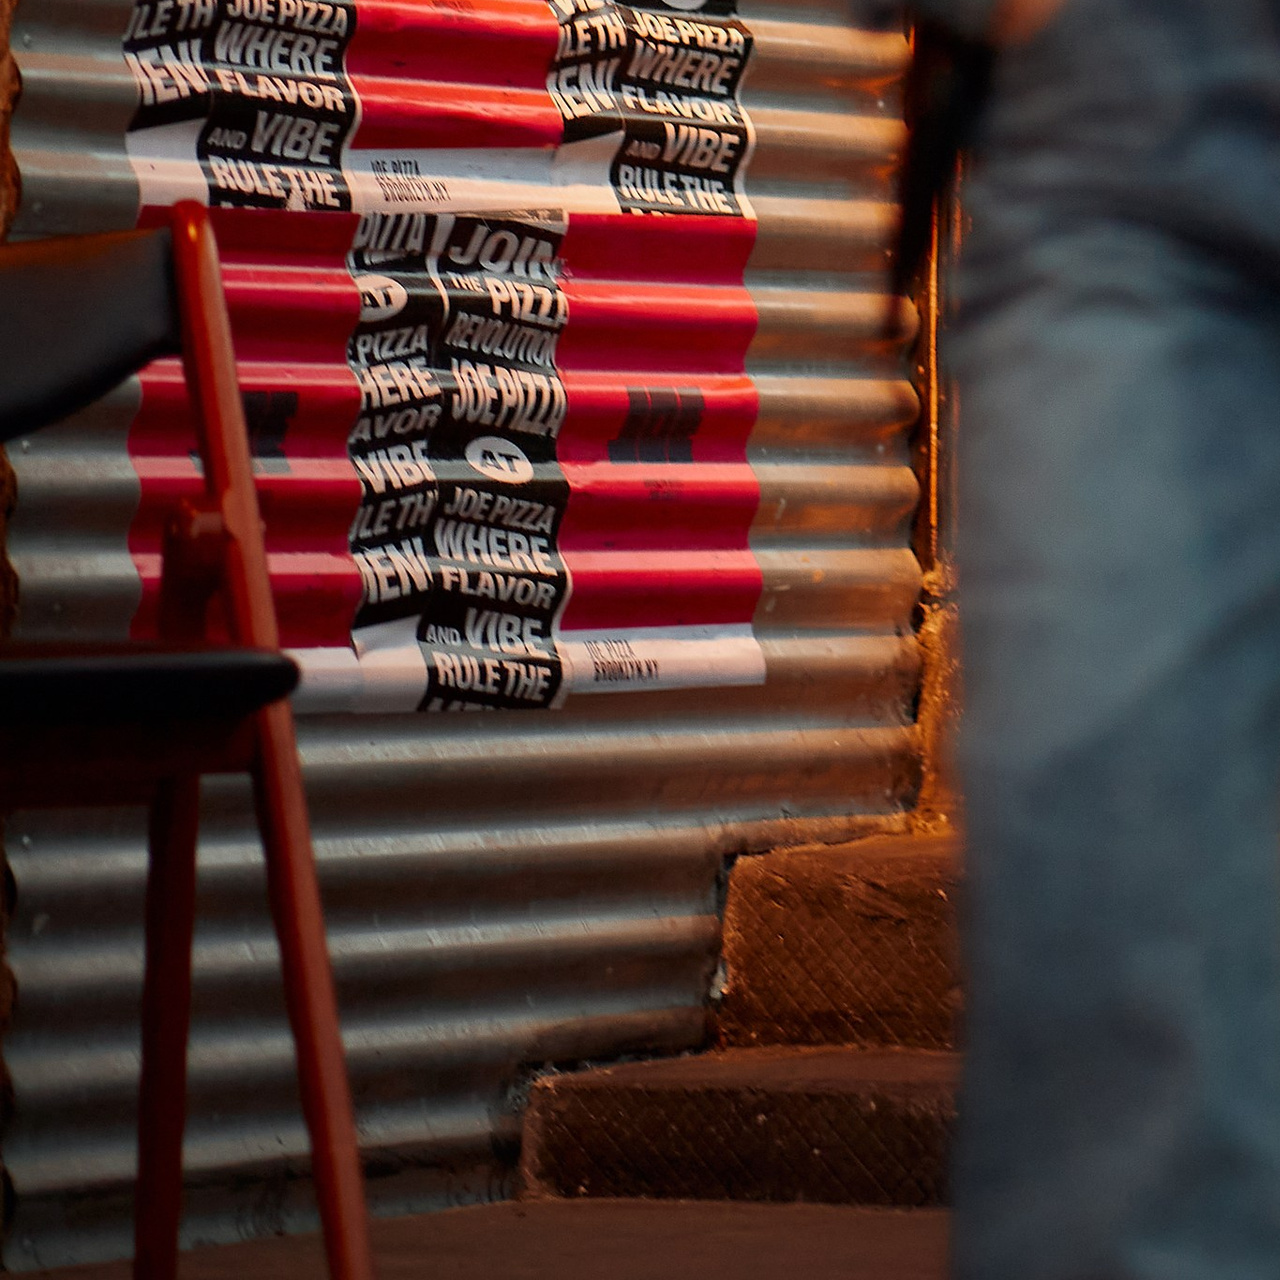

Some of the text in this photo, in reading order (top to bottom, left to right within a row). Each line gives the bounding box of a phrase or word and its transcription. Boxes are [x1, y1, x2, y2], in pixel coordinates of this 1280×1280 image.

[214, 21, 338, 81] WHERE
[631, 9, 744, 55] JOE PIZZA
[215, 69, 346, 113] FLAVOR
[627, 38, 740, 95] WHERE
[620, 84, 738, 126] FLAVOR
[207, 110, 339, 164] AND VIBE
[662, 122, 740, 173] VIBE
[208, 155, 283, 197] RULE
[619, 163, 733, 214] RULE THE
[484, 277, 569, 327] PIZZA
[445, 486, 556, 534] JOE PIZZA
[433, 517, 557, 576] WHERE
[440, 565, 556, 609] FLAVOR
[465, 607, 550, 659] VIBE
[432, 651, 552, 702] RULE THE
